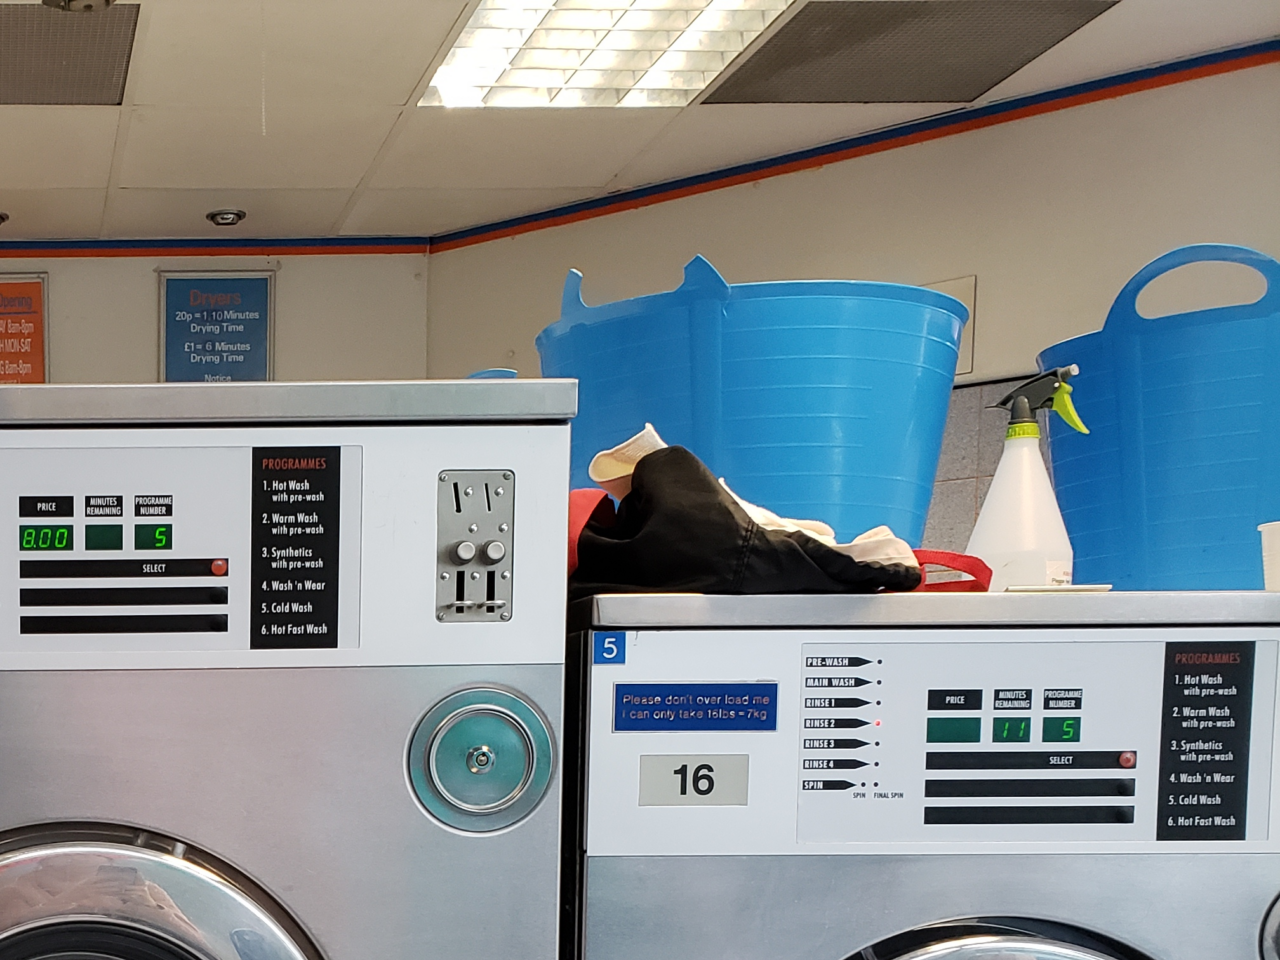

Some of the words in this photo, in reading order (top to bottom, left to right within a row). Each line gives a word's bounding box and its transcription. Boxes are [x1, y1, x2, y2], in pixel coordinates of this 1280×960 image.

[189, 289, 242, 308] Dryers
[175, 311, 193, 322] 20p
[223, 310, 260, 320] Minutes
[190, 323, 220, 334] Drying
[222, 322, 244, 332] Time
[5, 338, 32, 353] MON-SAT
[205, 341, 212, 351] 6
[215, 342, 251, 351] Minutes
[190, 353, 220, 364] Drying
[222, 352, 244, 362] Time
[204, 373, 232, 382] Notice
[262, 458, 327, 470] PROGRAMMES
[263, 480, 271, 491] 1.
[272, 480, 287, 491] Hot
[288, 480, 310, 491] Wash
[89, 497, 118, 506] MINUTES
[135, 496, 172, 506] PROGRAMME
[272, 492, 288, 502] with
[289, 492, 325, 504] pre-wash
[37, 502, 57, 512] PRICE
[86, 506, 121, 516] REMAINING
[140, 506, 166, 515] NUMBER
[262, 513, 271, 524] 2.
[271, 513, 295, 524] Warm
[296, 513, 318, 523] Wash
[155, 527, 167, 547] 5
[271, 525, 287, 535] with
[288, 525, 324, 537] pre-wash
[22, 528, 68, 548] 8.00
[261, 548, 270, 558] 3.
[271, 547, 313, 560] Synthetics
[142, 564, 166, 573] SELECT
[271, 559, 287, 569] with
[288, 558, 324, 571] pre-wash
[261, 581, 270, 591] 4.
[271, 580, 293, 591] Wash
[304, 580, 326, 591] Wear
[261, 603, 270, 614] 5.
[271, 602, 290, 614] Cold
[291, 602, 313, 613] Wash
[261, 624, 270, 635] 6.
[271, 624, 286, 635] Hot
[287, 624, 305, 635] Fast
[306, 623, 328, 634] Wash
[602, 637, 618, 659] 5
[807, 658, 849, 666] PRE-WASH
[1175, 653, 1240, 664] PROGRAMMES
[806, 678, 828, 686] MAIN
[831, 678, 855, 686] WASH
[623, 694, 661, 705] Please
[665, 694, 693, 705] don't
[696, 696, 722, 705] over
[724, 694, 749, 705] load
[752, 696, 770, 705] me
[629, 711, 650, 719] can
[653, 709, 675, 721] only
[679, 709, 703, 719] take
[1062, 720, 1075, 739] 5
[673, 764, 715, 796] 16
